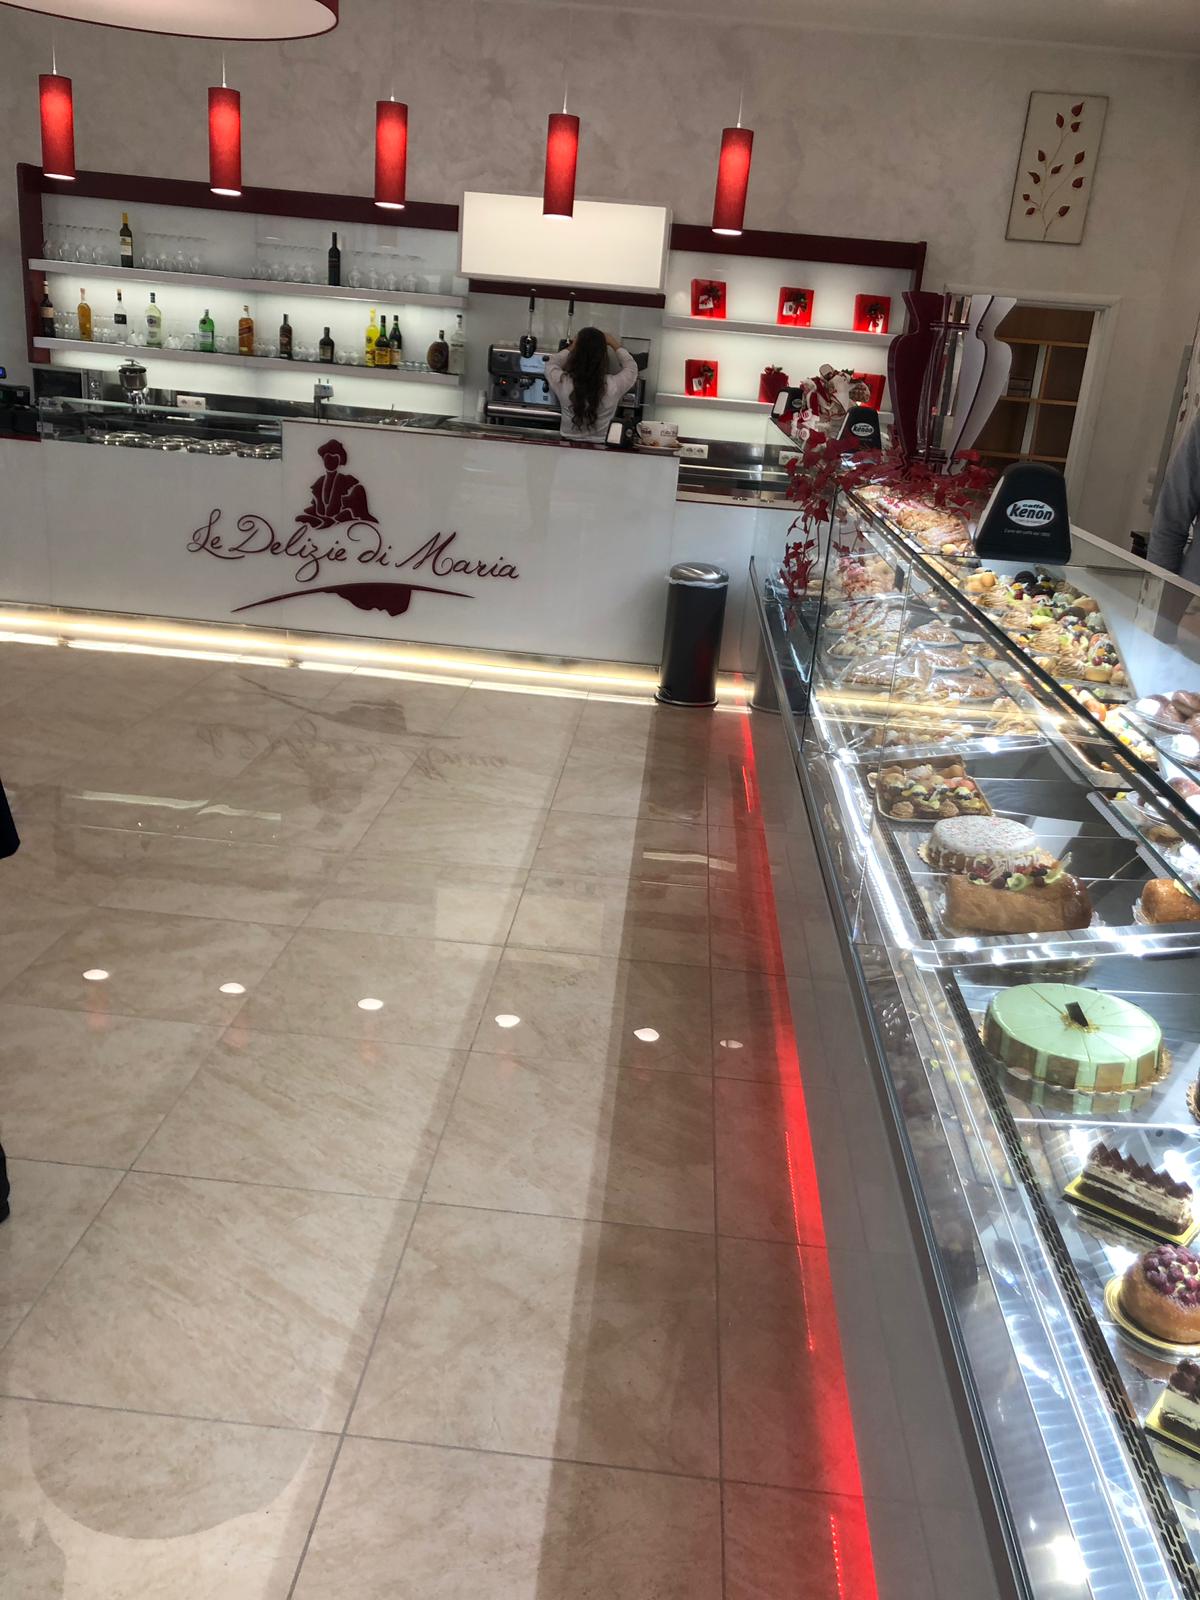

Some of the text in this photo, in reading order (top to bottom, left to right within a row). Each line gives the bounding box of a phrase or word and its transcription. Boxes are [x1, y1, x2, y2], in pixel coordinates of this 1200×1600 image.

[186, 508, 520, 582] Le Delizie di Maria
